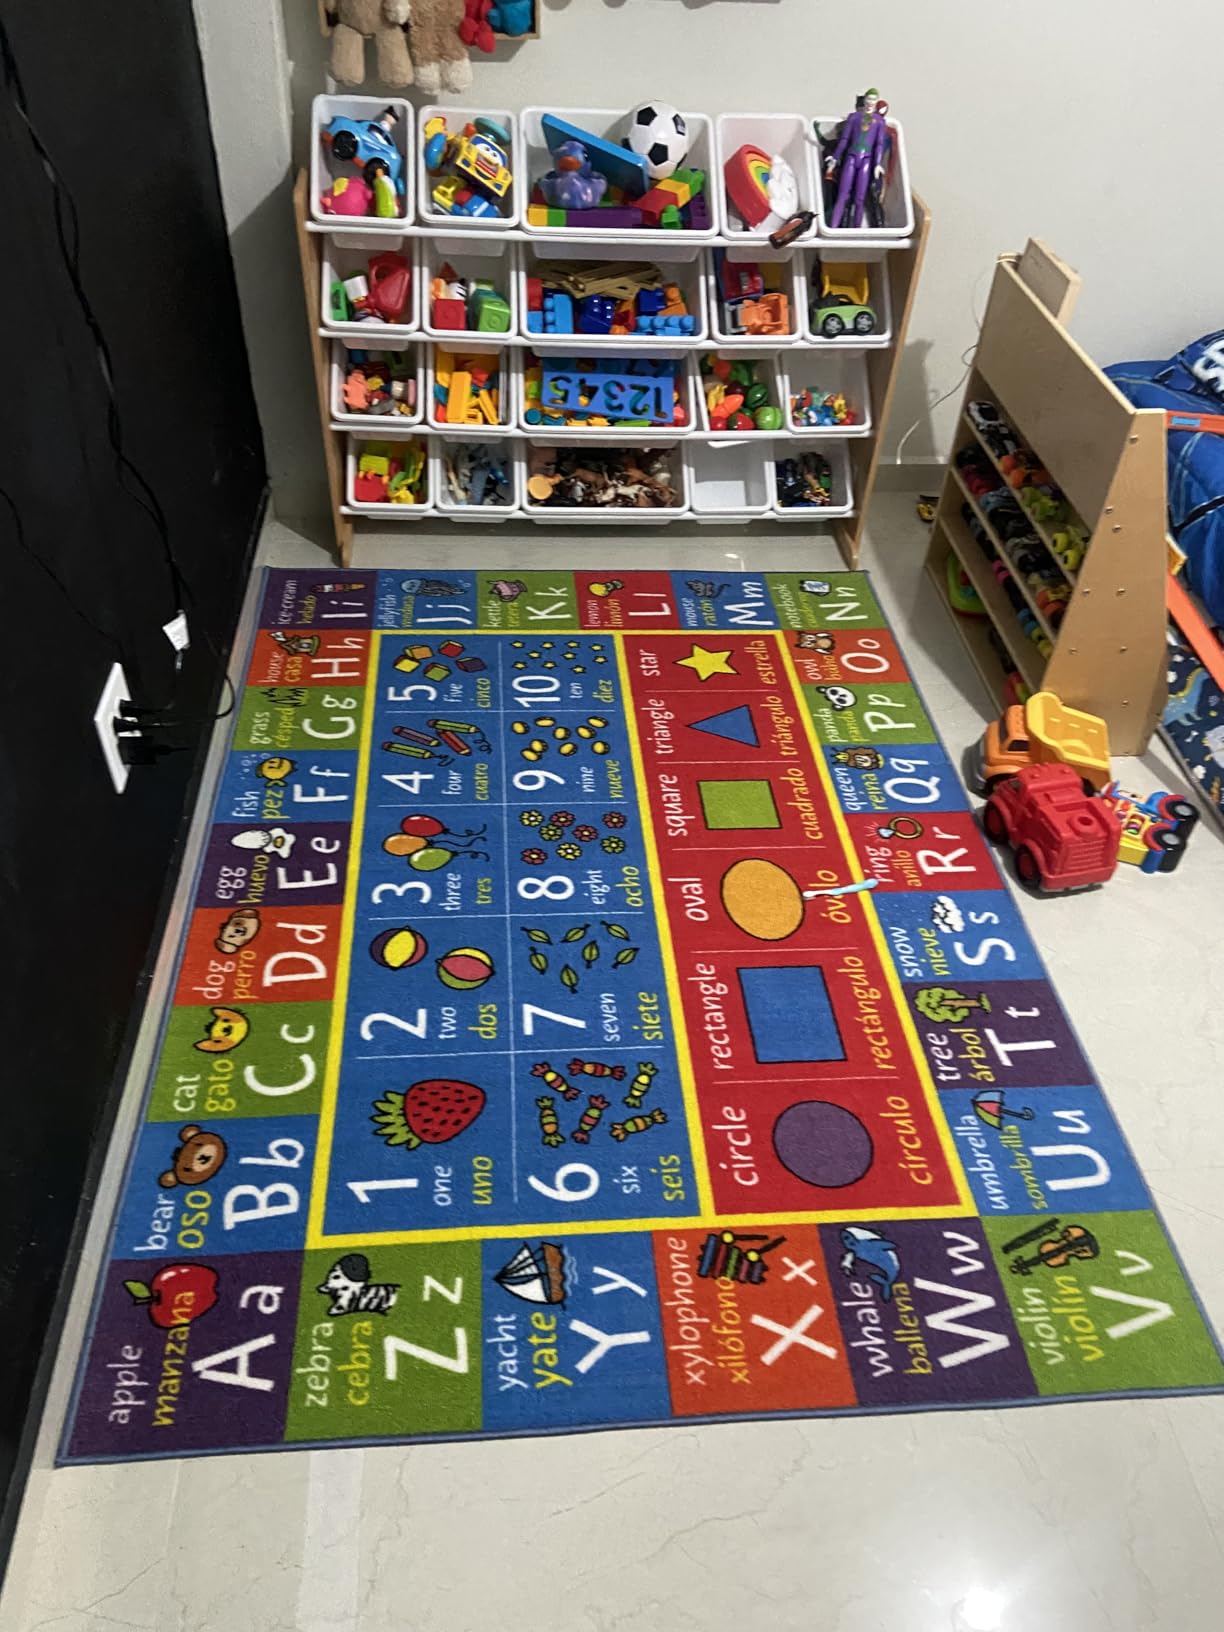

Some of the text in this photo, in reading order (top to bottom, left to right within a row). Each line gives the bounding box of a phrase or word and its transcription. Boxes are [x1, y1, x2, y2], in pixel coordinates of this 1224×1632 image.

[298, 594, 317, 624] helado
[377, 592, 401, 627] jellyfish
[483, 600, 498, 627] kettle
[583, 599, 598, 627] lemon
[604, 599, 620, 627] limón
[682, 598, 698, 626] mouse
[701, 599, 716, 626] ratón
[771, 583, 802, 628] notebook
[260, 650, 284, 683] house
[285, 655, 303, 682] casa
[639, 649, 661, 677] star
[744, 639, 776, 685] estrella
[795, 659, 822, 680] owl
[388, 685, 437, 701] 5
[443, 682, 463, 703] five
[471, 678, 491, 708] cinco
[512, 675, 561, 708] 10
[569, 682, 584, 699] ten
[592, 679, 613, 703] diez
[251, 711, 271, 745] grass
[641, 698, 673, 755] triangle
[760, 694, 795, 756] triángulo
[812, 707, 846, 742] panda
[838, 710, 868, 742] panda
[382, 771, 434, 795] 4
[442, 770, 462, 795] four
[475, 763, 489, 801] cuatro
[513, 769, 565, 790] 9
[575, 766, 594, 793] nine
[604, 760, 624, 799] nueve
[835, 767, 862, 811] queen
[855, 773, 887, 810] reina
[232, 791, 260, 817] fish
[261, 789, 291, 820] pez
[660, 773, 696, 837] square
[782, 768, 822, 840] cuadrado
[216, 866, 247, 899] egg
[237, 855, 270, 904] huevo
[863, 845, 894, 883] ring
[892, 849, 922, 888] anillo
[372, 881, 431, 904] 3
[439, 873, 462, 911] three
[476, 878, 492, 905] tres
[517, 875, 575, 900] 8
[579, 870, 610, 905] eight
[613, 866, 643, 906] ocho
[668, 877, 709, 921] oval
[808, 869, 852, 925] óvlo
[890, 927, 922, 977] snow
[917, 927, 952, 976] nieve
[192, 960, 236, 1000] dog
[233, 950, 259, 1000] perro
[361, 1008, 427, 1041] 2
[438, 1006, 457, 1039] two
[468, 1003, 497, 1039] dos
[522, 1003, 587, 1035] 7
[601, 993, 620, 1042] seven
[633, 992, 663, 1040] siete
[688, 963, 734, 1071] rectangle
[837, 955, 896, 1070] rectángulo
[927, 1033, 961, 1081] tree
[951, 1027, 996, 1082] árbol
[173, 1074, 201, 1112] cat
[204, 1059, 237, 1112] gato
[712, 1105, 760, 1187] circle
[954, 1115, 1008, 1210] umbrella
[433, 1165, 453, 1206] one
[472, 1156, 493, 1205] uno
[527, 1162, 600, 1202] 6
[612, 1165, 641, 1195] six
[650, 1153, 686, 1201] seis
[998, 1123, 1048, 1210] sombrilla
[346, 1178, 419, 1203] 1
[133, 1193, 176, 1251] bear
[177, 1190, 212, 1248] oso
[664, 1236, 715, 1386] xylophone
[842, 1282, 893, 1377] whale
[892, 1282, 932, 1375] ballena
[1016, 1288, 1066, 1366] violin
[528, 1311, 573, 1389] yate
[711, 1277, 751, 1385] xilófono
[152, 1291, 196, 1428] manzana
[296, 1321, 334, 1408] zebra
[337, 1320, 375, 1407] cebra
[486, 1313, 529, 1391] yacht
[106, 1345, 150, 1425] apple
